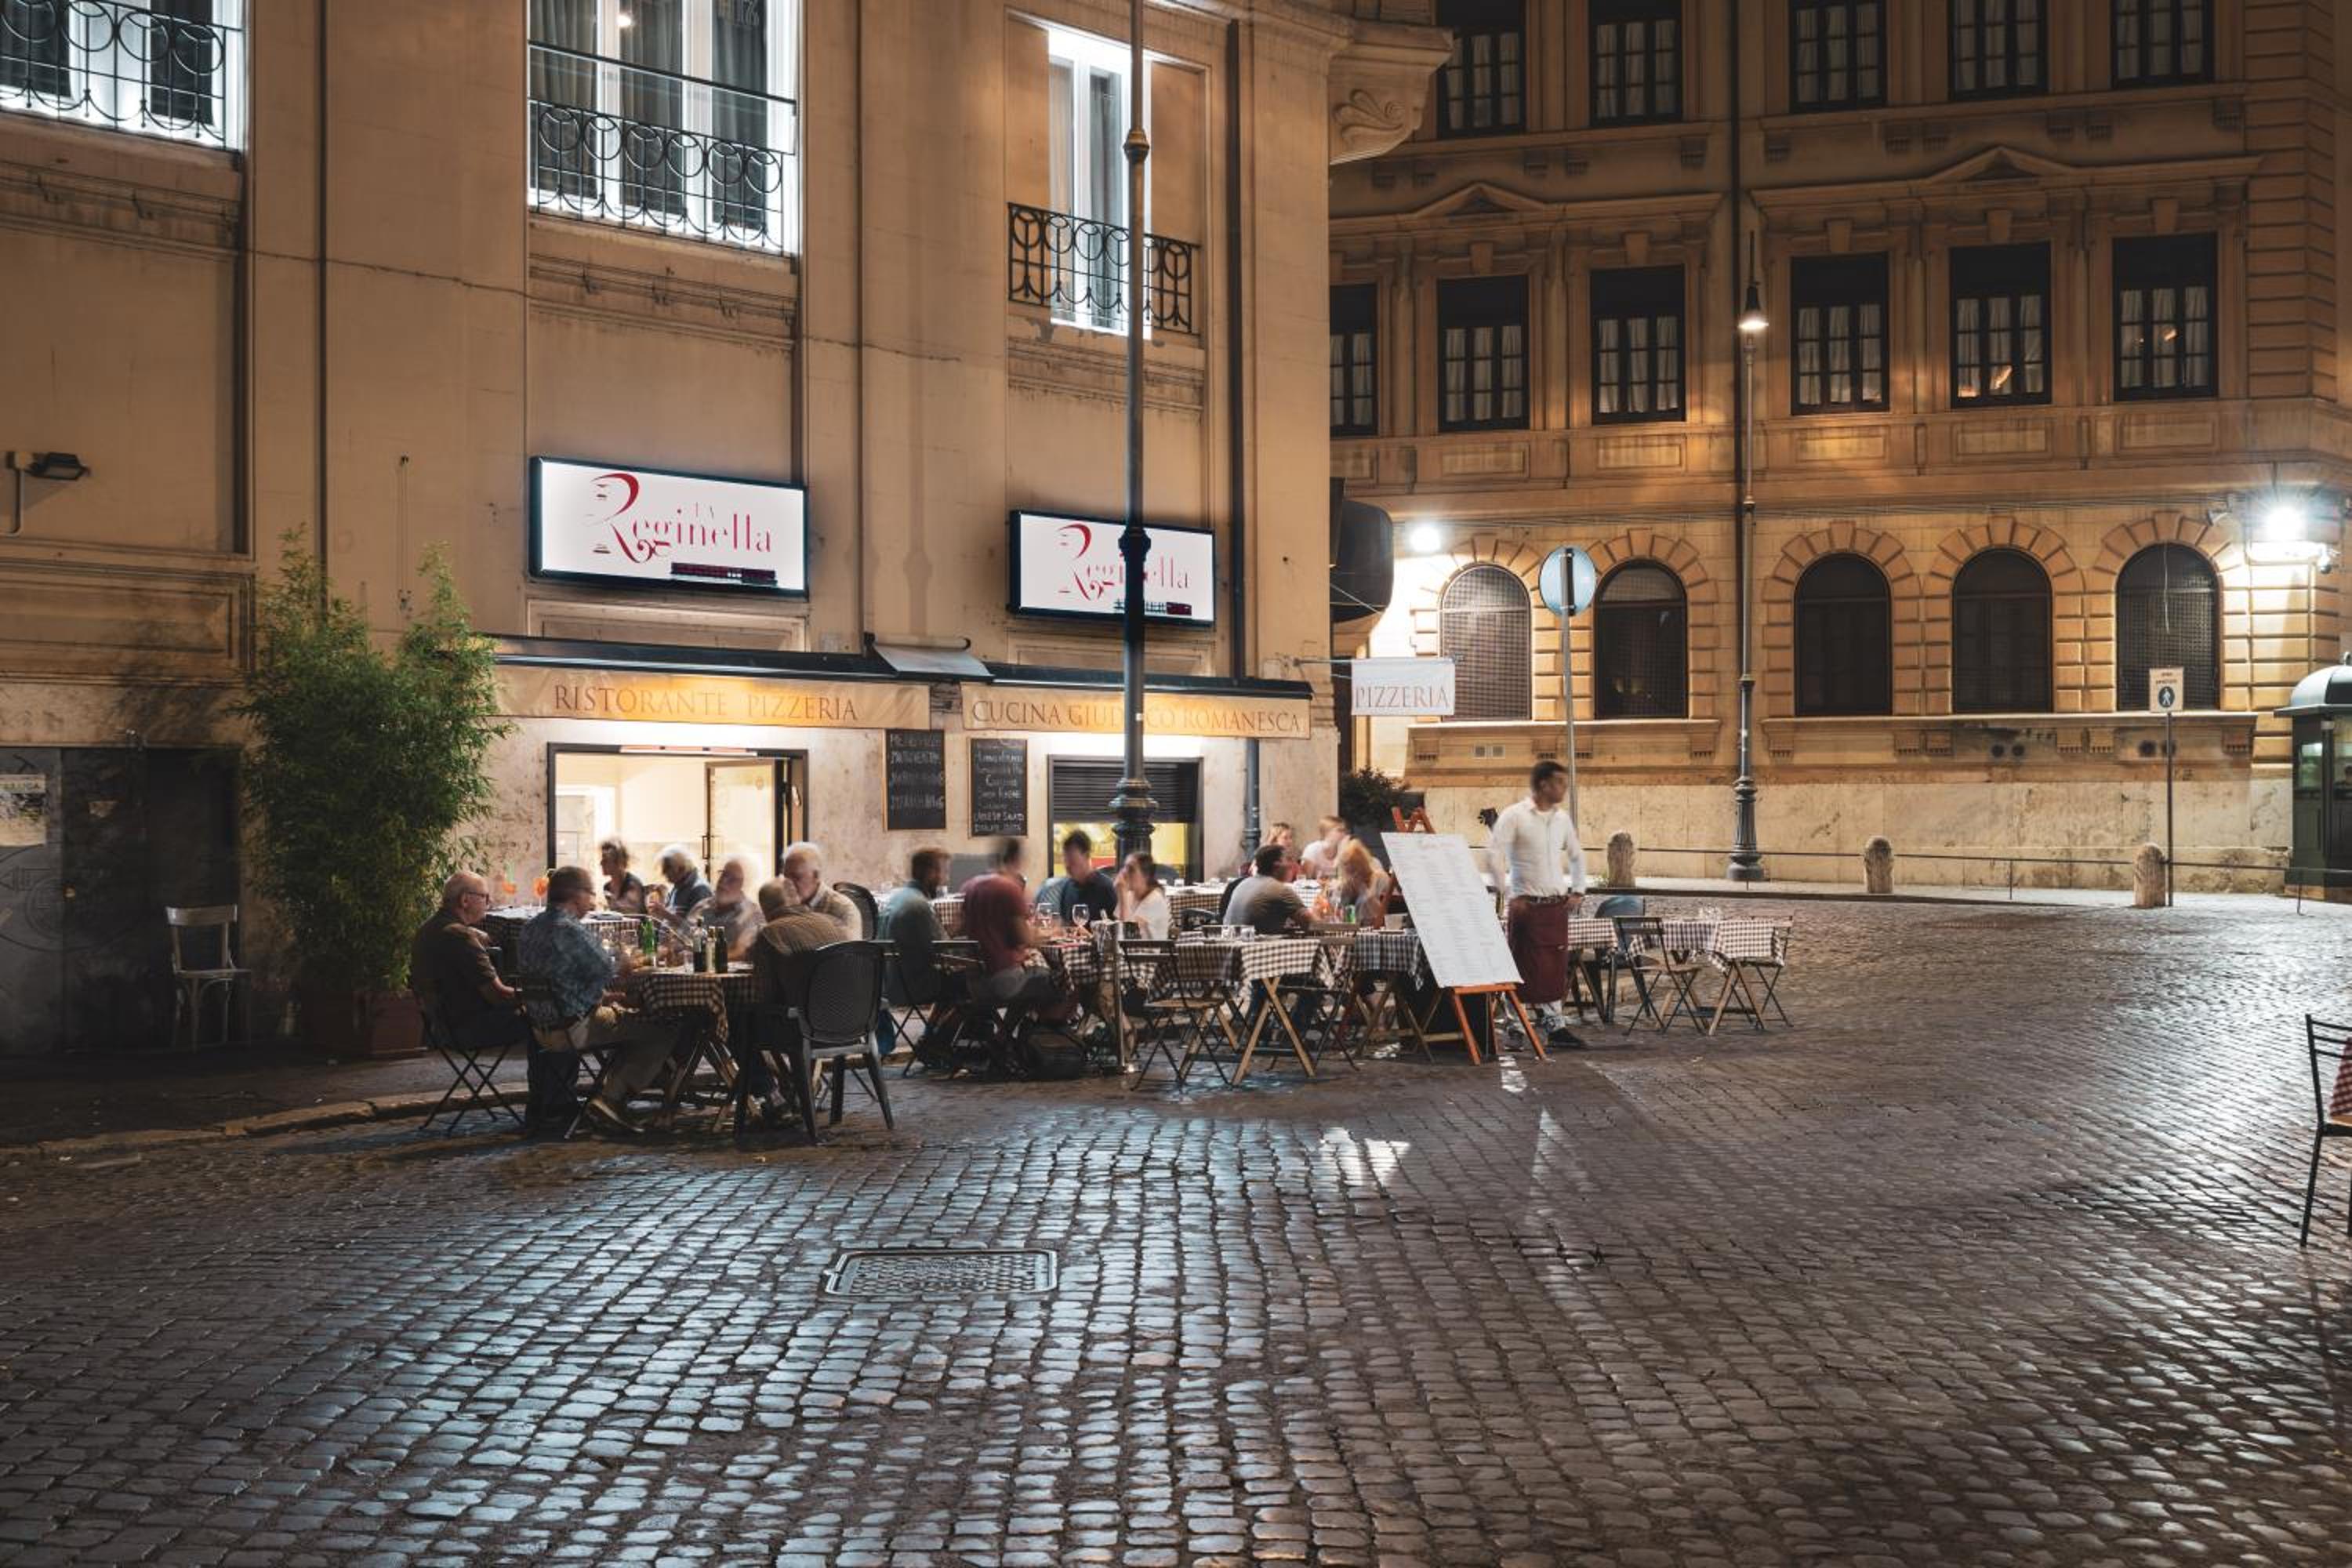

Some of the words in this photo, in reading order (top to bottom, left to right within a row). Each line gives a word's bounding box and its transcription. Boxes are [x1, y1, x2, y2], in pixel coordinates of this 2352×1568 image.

[1056, 523, 1189, 601] Regiella
[554, 684, 728, 716] RISTORANTE
[746, 692, 858, 721] PIZZERIA
[1356, 685, 1449, 708] PIZZERIA
[971, 700, 1062, 724] CUCINA
[1068, 704, 1175, 728] GIUDCO
[1183, 707, 1300, 731] ROMANESCA
